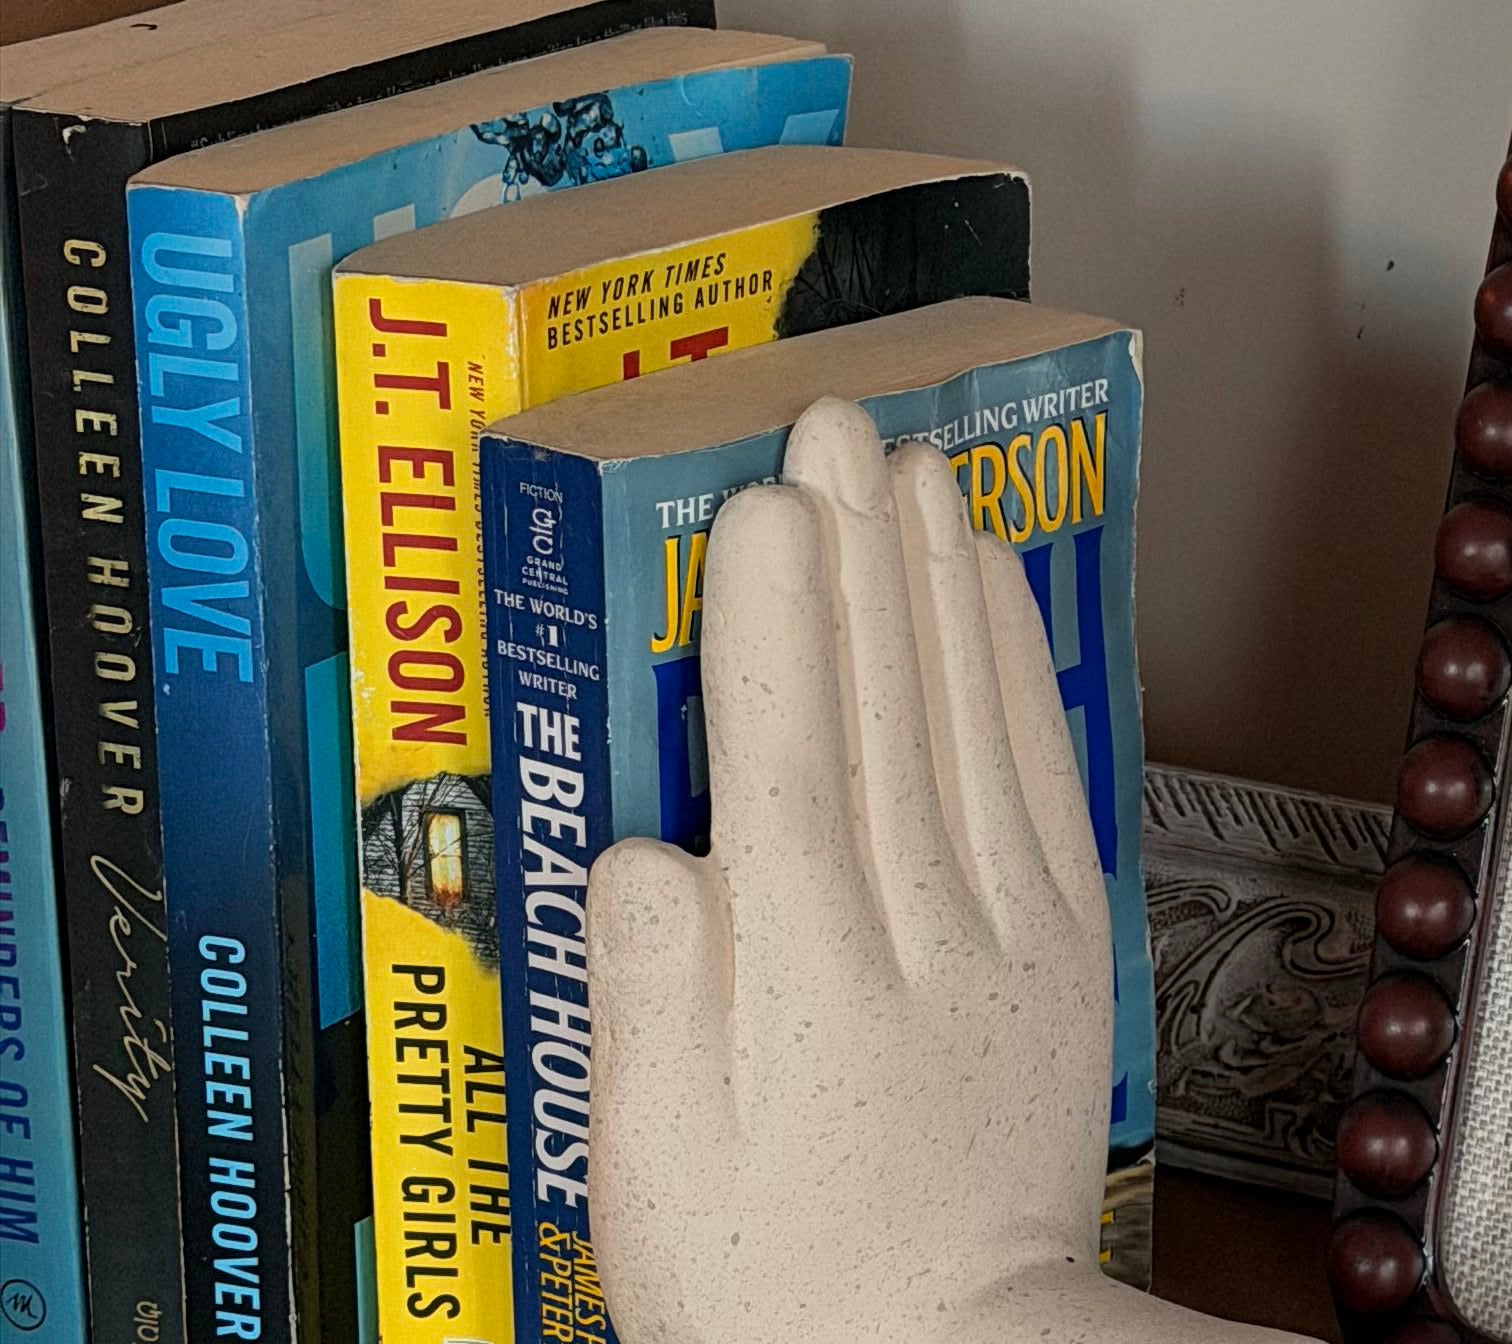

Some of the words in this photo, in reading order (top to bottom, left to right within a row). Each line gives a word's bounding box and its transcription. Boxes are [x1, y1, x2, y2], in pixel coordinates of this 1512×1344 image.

[547, 286, 592, 320] NEW
[601, 269, 655, 305] YORK
[664, 252, 727, 289] TIMES
[547, 291, 685, 350] BESTSELLING
[694, 269, 773, 310] AUTHOR
[63, 238, 125, 525] COLLEEN
[141, 230, 244, 457] UGLY
[368, 297, 451, 416] J.T.
[467, 360, 484, 403] NEW
[881, 401, 1019, 453] SELLING
[1022, 377, 1110, 425] WRITER
[519, 481, 564, 504] FICTION
[655, 492, 715, 529] THE
[152, 468, 254, 685] LOVE
[377, 444, 468, 747] ELLISON
[494, 588, 526, 610] THE
[529, 597, 598, 630] WORLD'S
[521, 565, 569, 586] CENTRAL
[526, 555, 562, 572] GRAND
[497, 639, 600, 681] BESTSELLING
[535, 623, 559, 648] #1
[85, 556, 145, 816] HOOVER
[518, 669, 578, 700] WRITER
[516, 701, 582, 762] THE
[518, 754, 590, 984] BEACH
[90, 854, 172, 1123] Verity
[198, 934, 256, 1142] COLLEEN
[391, 963, 454, 1156] PRETTY
[463, 1044, 507, 1133] ALL
[529, 992, 593, 1209] HOUSE
[208, 1156, 262, 1341] HOOVER
[401, 1175, 462, 1320] GIRLS
[539, 1251, 575, 1344] PETER
